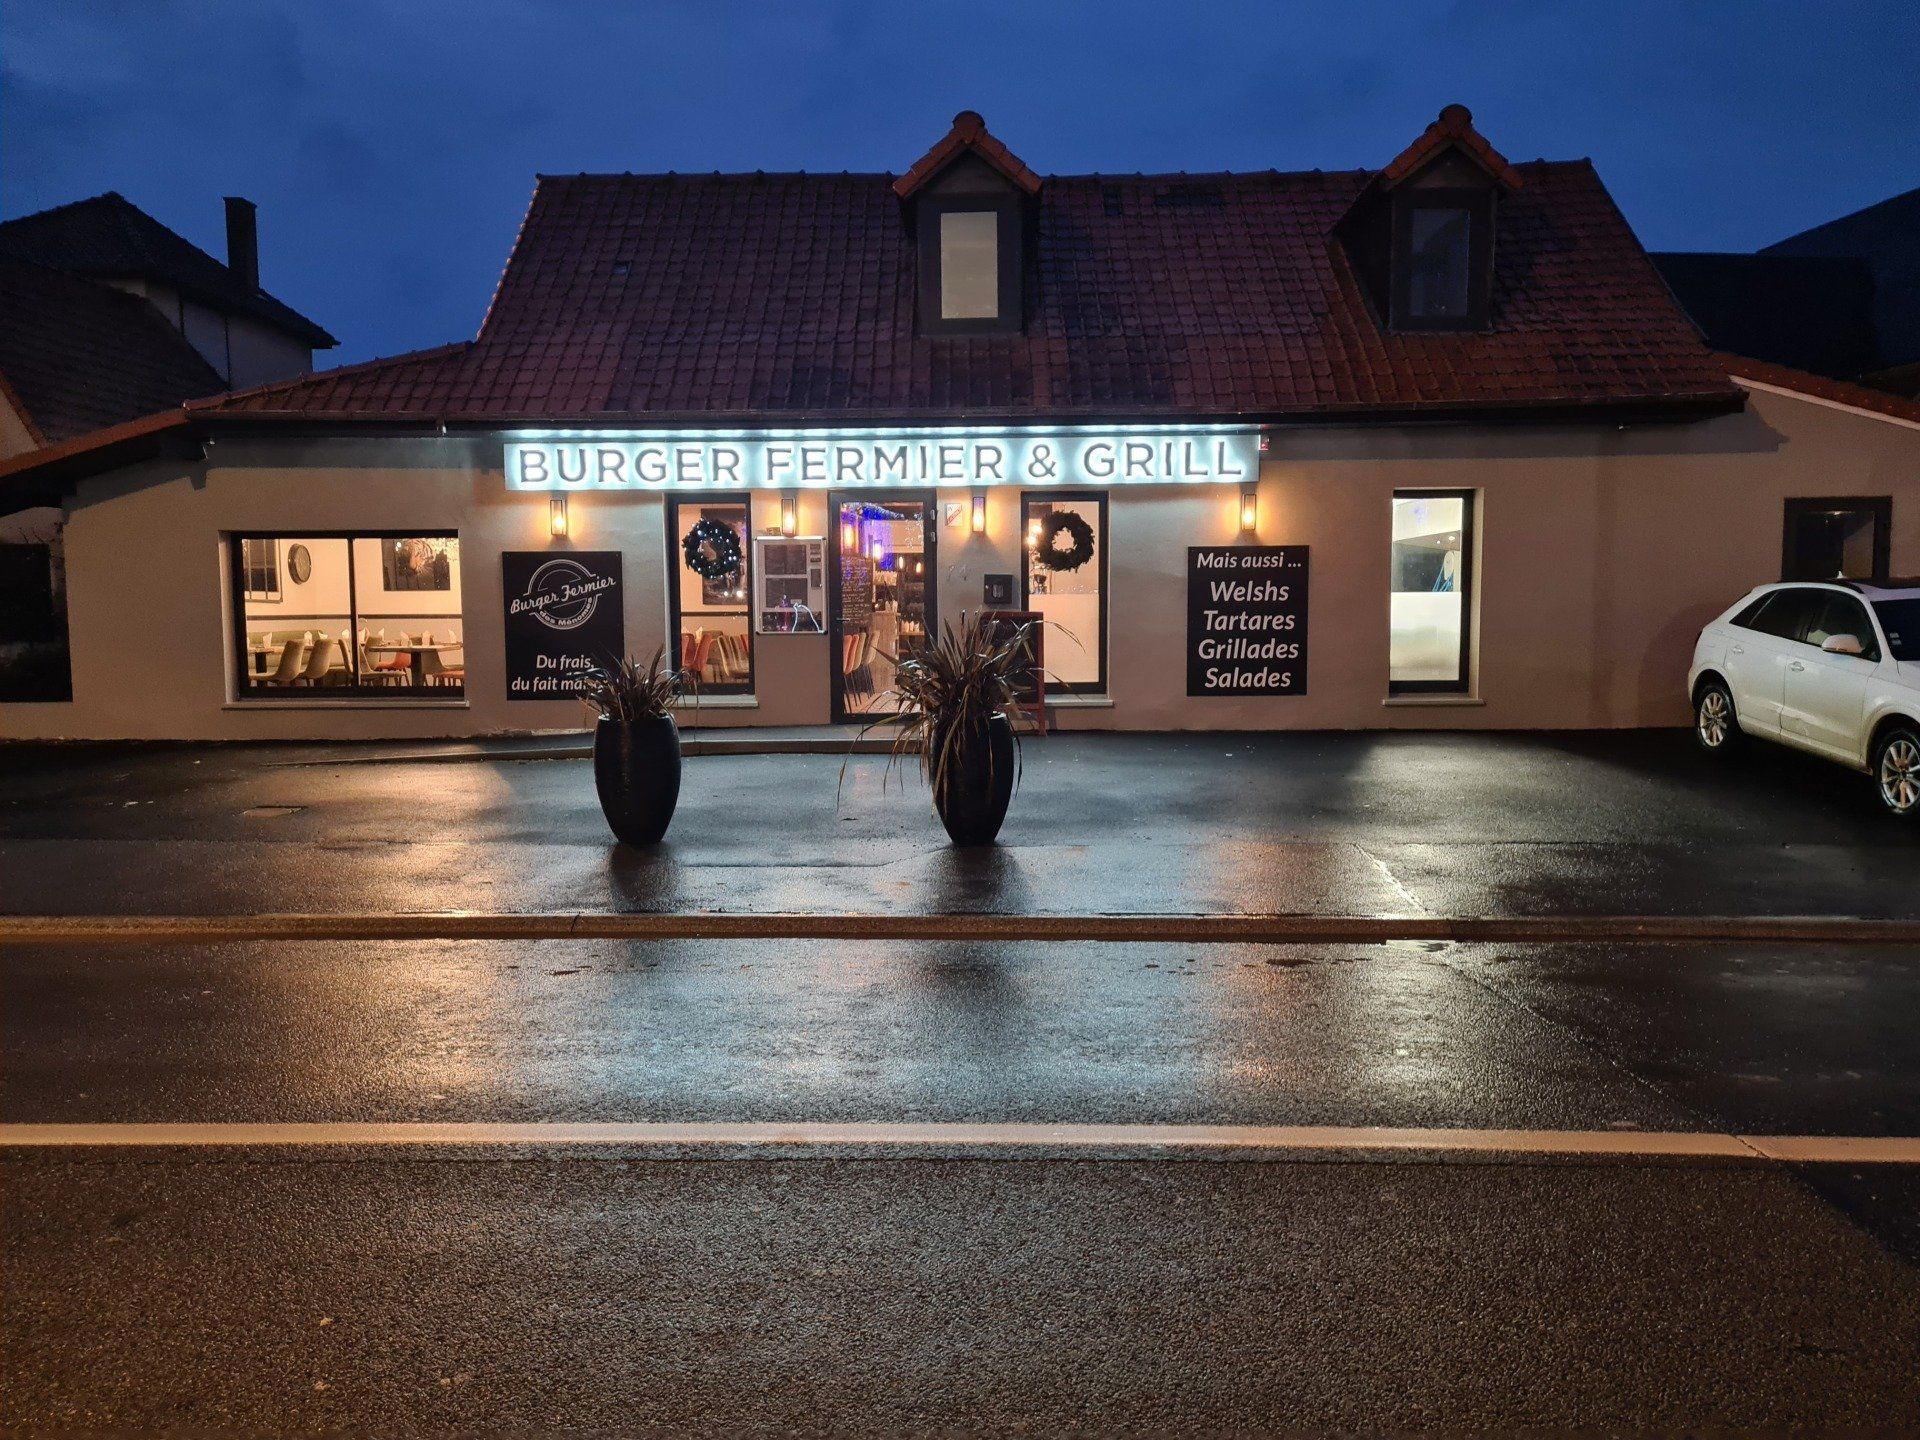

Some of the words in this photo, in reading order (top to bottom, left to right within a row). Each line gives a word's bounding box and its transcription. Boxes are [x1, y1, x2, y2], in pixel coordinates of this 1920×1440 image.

[519, 448, 741, 483] BURGER
[766, 445, 1003, 481] FERMIER
[1027, 443, 1056, 478] &
[1083, 441, 1242, 478] GRILL
[1197, 552, 1237, 569] Mais
[1241, 551, 1284, 568] aussi
[510, 592, 560, 614] Burger
[561, 576, 616, 602] Fermier
[1210, 580, 1290, 602] Welshs
[1203, 609, 1296, 631] Tartares
[1198, 638, 1299, 659] Grillades
[536, 655, 557, 669] Du
[560, 654, 594, 671] frais,
[511, 677, 530, 691] du
[533, 677, 558, 692] fait
[1204, 666, 1292, 688] Salades
